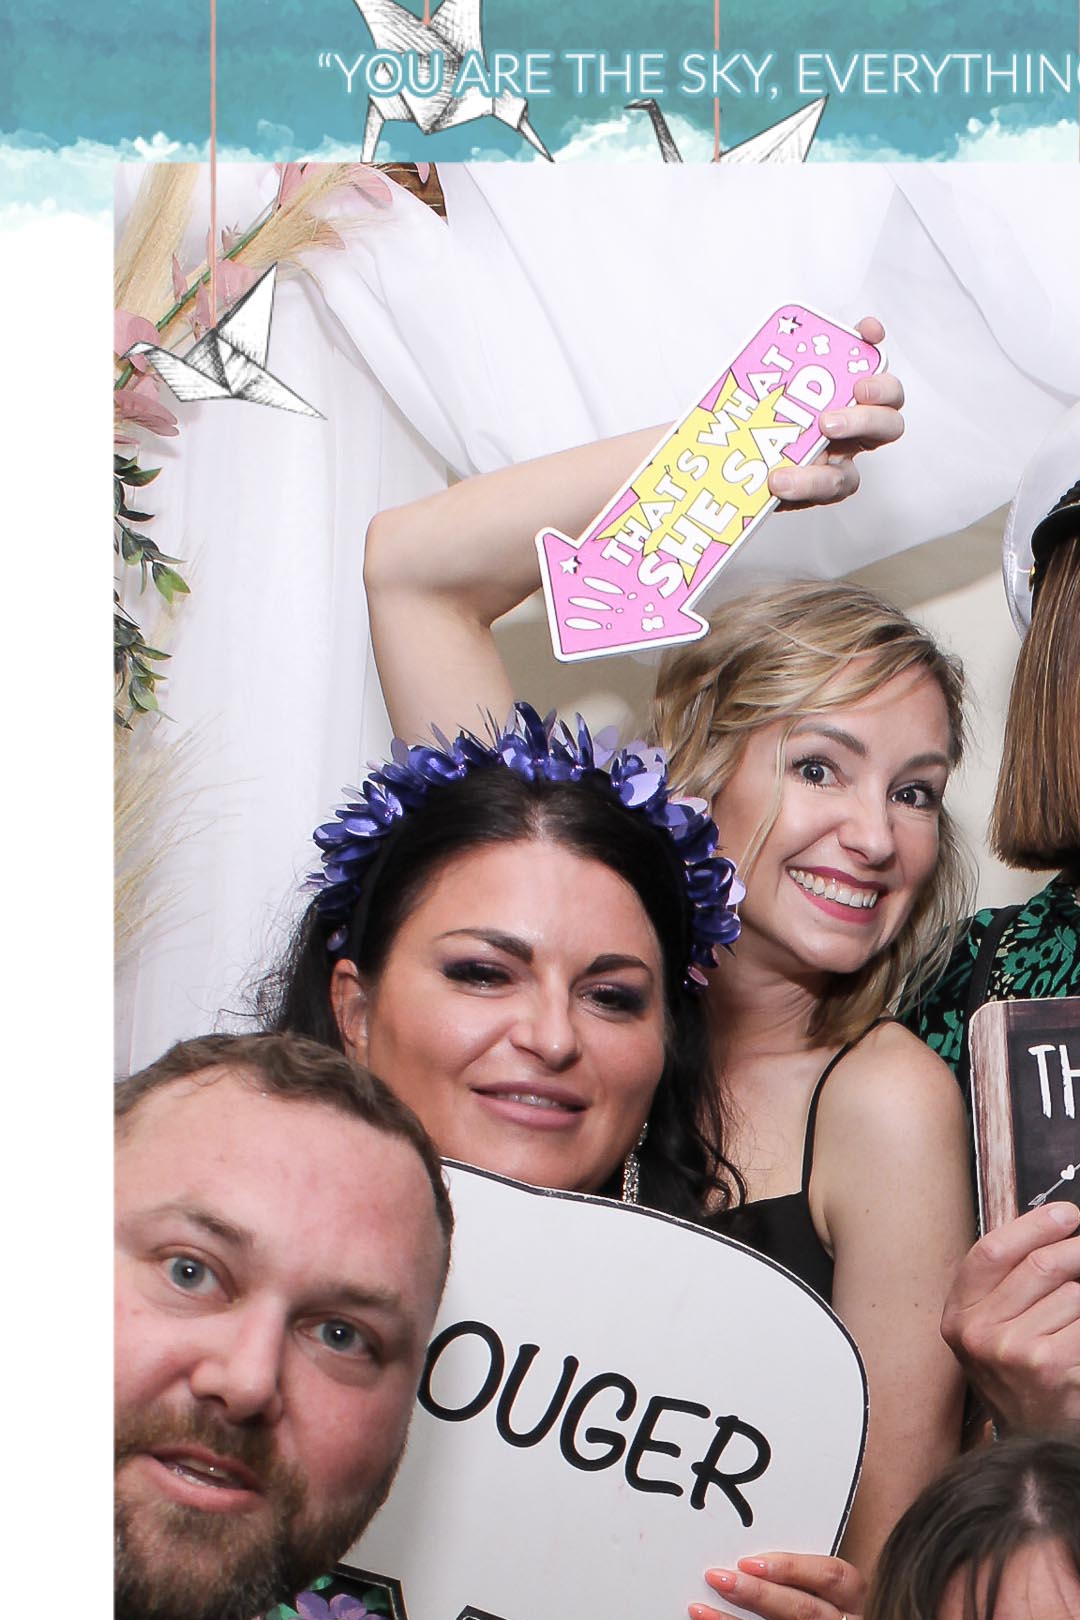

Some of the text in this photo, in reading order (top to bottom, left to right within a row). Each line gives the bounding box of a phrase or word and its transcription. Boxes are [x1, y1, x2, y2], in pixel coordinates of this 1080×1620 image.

[637, 363, 836, 599] SHE SAID
[696, 344, 794, 447] WHAT
[416, 1320, 771, 1528] OUGER
